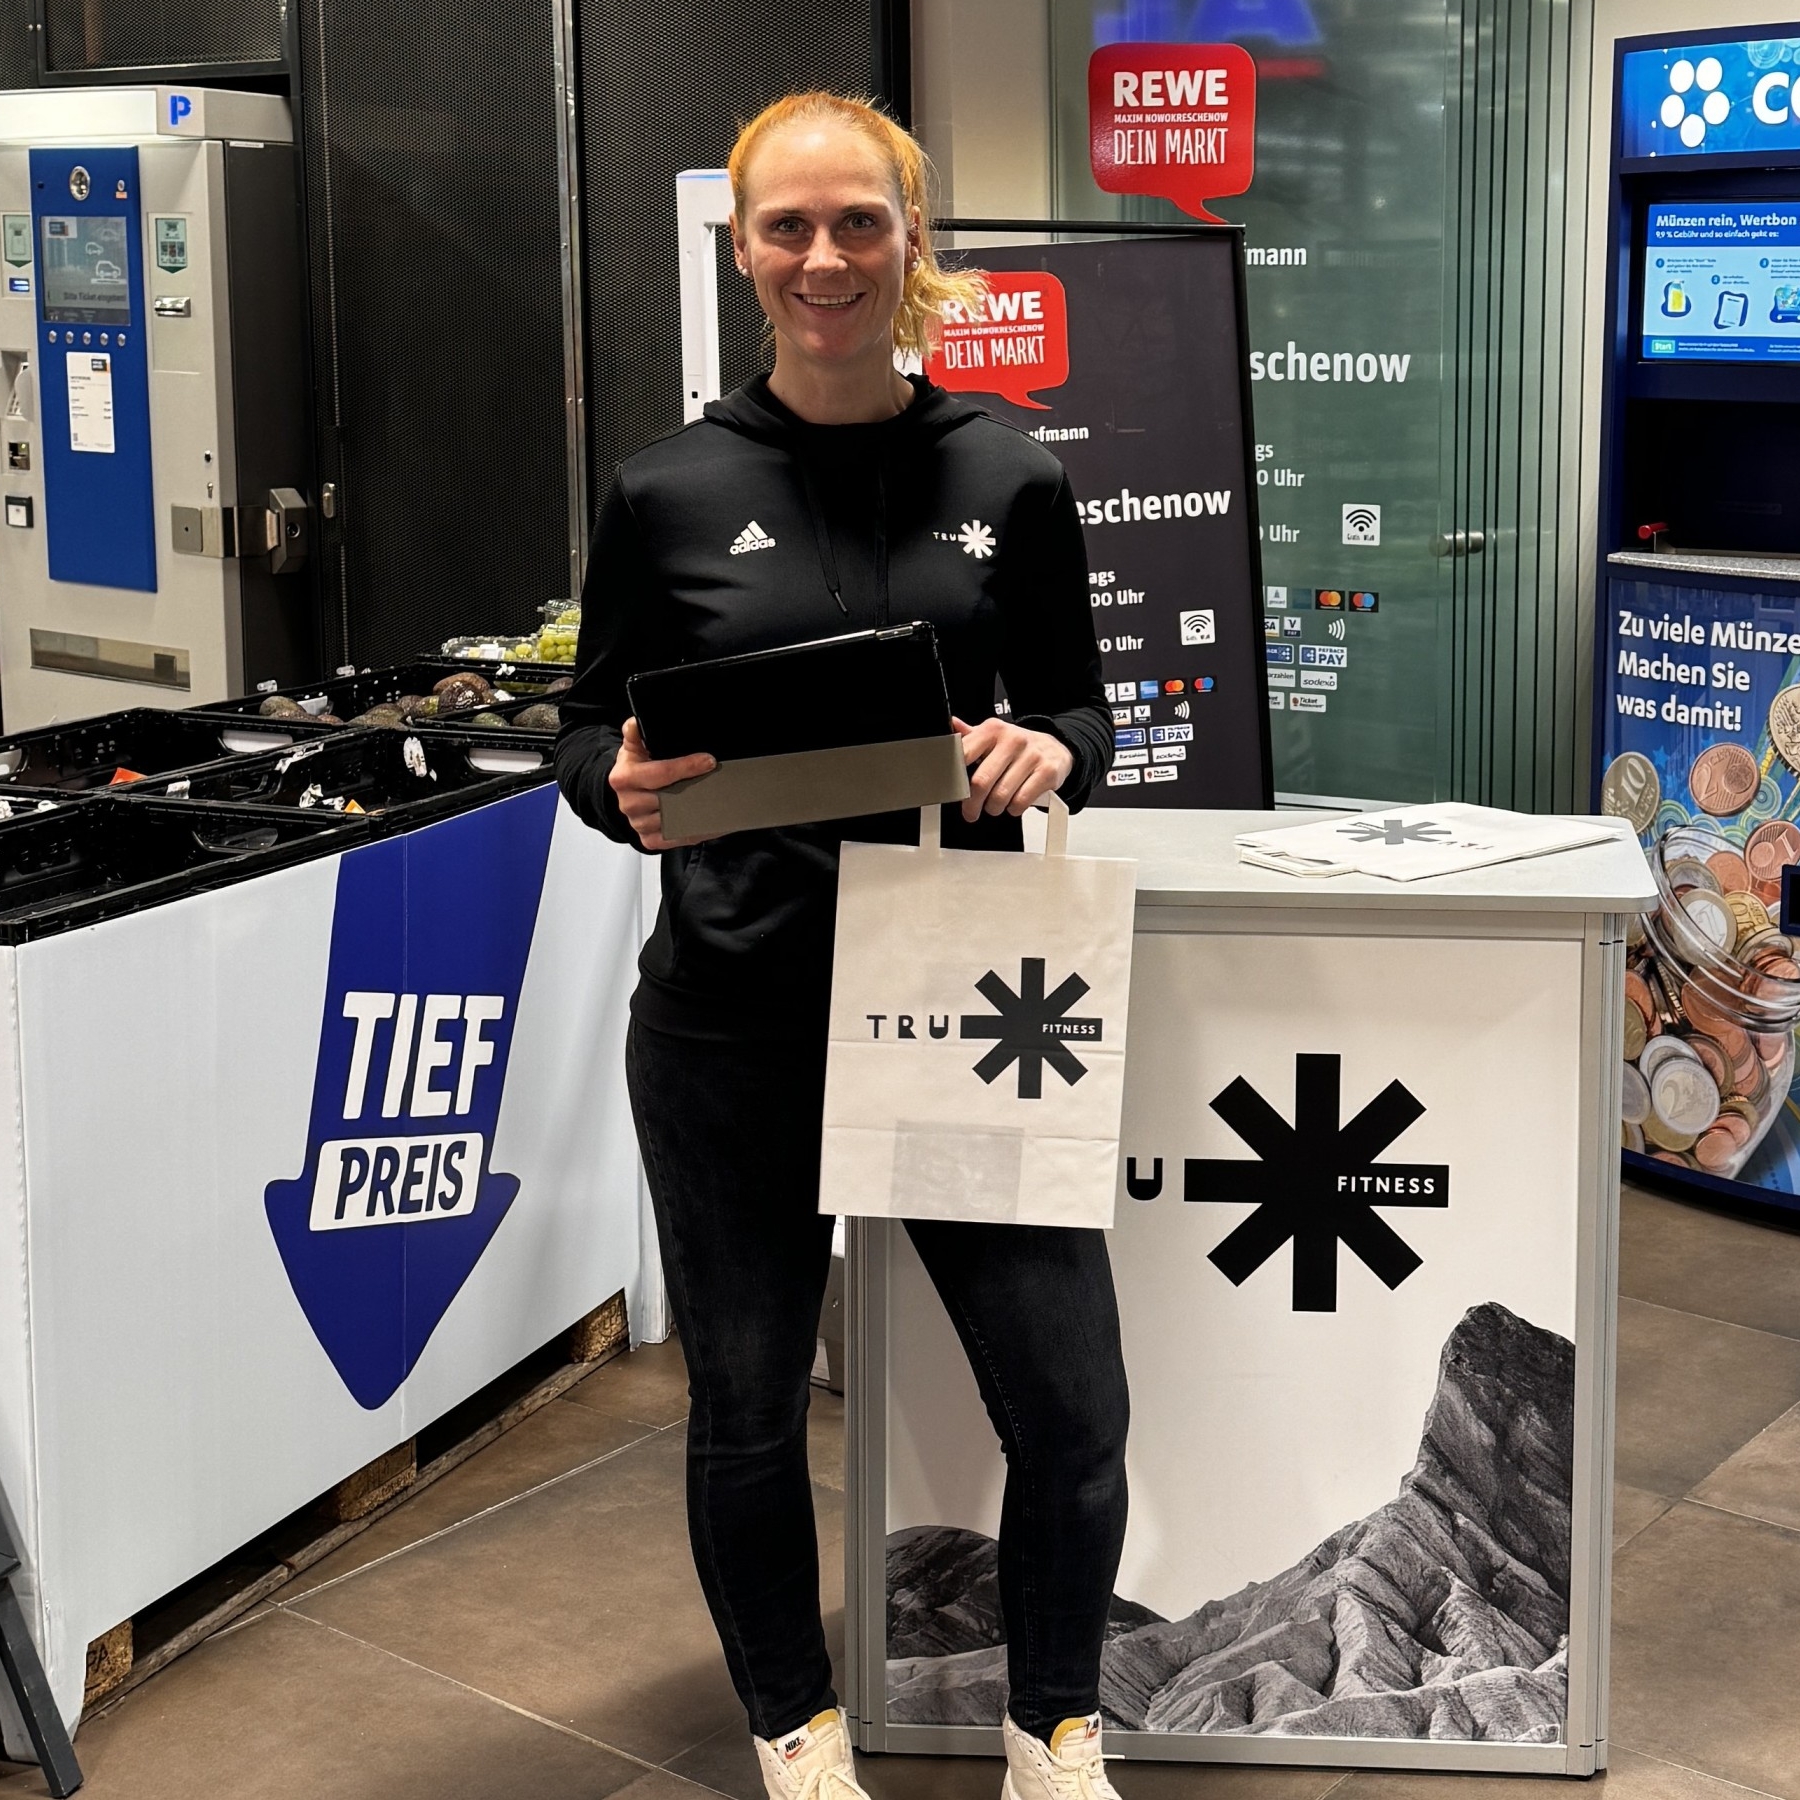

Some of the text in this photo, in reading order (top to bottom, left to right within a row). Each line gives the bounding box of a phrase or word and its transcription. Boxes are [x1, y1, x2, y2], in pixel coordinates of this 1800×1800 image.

[1113, 69, 1229, 107] REWE
[1752, 71, 1800, 126] C
[169, 95, 192, 125] P
[1114, 112, 1229, 123] MAXIM NOWOKRESCHENOW
[1113, 128, 1229, 165] DEIN MARKT
[1656, 212, 1797, 228] Münzen rein, Wertbon
[1674, 230, 1699, 238] Gebühr
[1700, 230, 1714, 238] und
[1724, 230, 1751, 238] einfach
[1244, 242, 1307, 265] mann
[944, 327, 970, 338] MAXIM
[945, 335, 1046, 370] DEIN MARKT
[1654, 341, 1672, 351] Start
[1274, 468, 1305, 487] Uhr
[932, 531, 957, 542] TRU
[1269, 523, 1301, 542] Uhr
[729, 536, 776, 556] adidas
[1116, 588, 1145, 606] Uhr
[1618, 610, 1644, 638] Zu
[1649, 613, 1706, 646] viele
[1116, 635, 1144, 652] Uhr
[1318, 653, 1345, 665] PAY
[1617, 650, 1751, 692] Machen Sie
[1616, 693, 1742, 733] was damit!
[1167, 730, 1191, 741] PAY
[866, 1014, 1096, 1040] TRU FITNESS
[342, 991, 505, 1120] TIEF
[334, 1140, 467, 1220] PREIS
[1337, 1175, 1436, 1195] FITNESS
